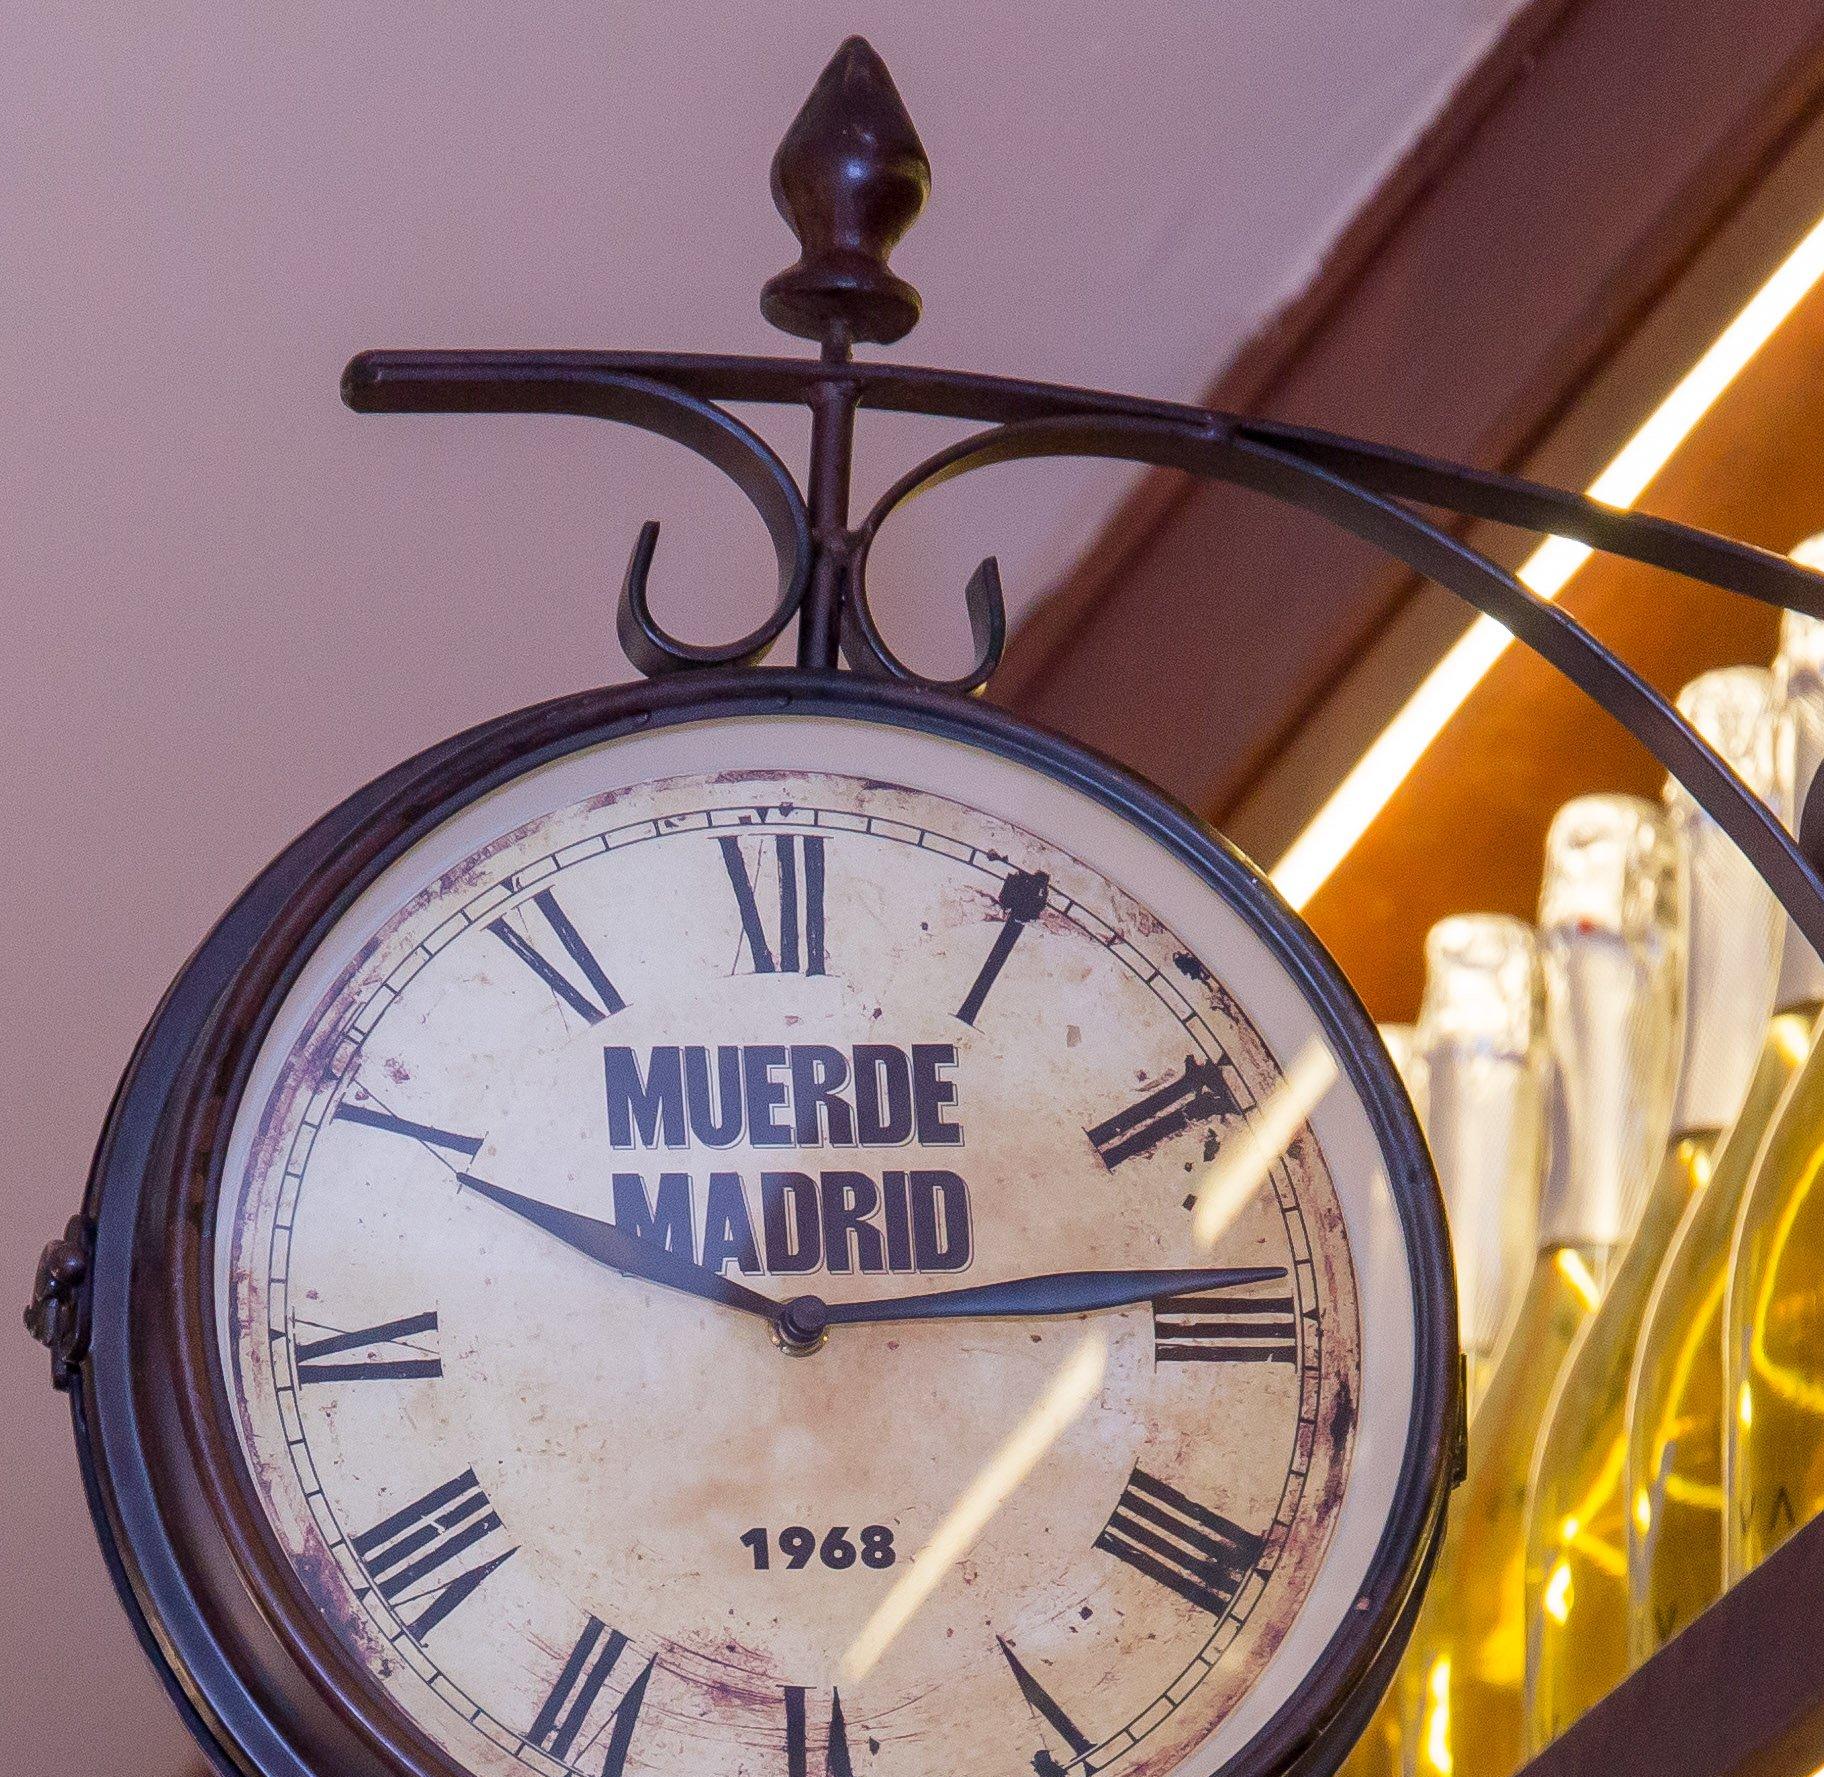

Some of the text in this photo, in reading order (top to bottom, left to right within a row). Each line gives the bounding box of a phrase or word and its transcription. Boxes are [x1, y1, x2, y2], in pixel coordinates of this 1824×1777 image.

[602, 1043, 966, 1150] MUERDE
[610, 1170, 974, 1276] MADRID
[739, 1523, 898, 1572] 1968
